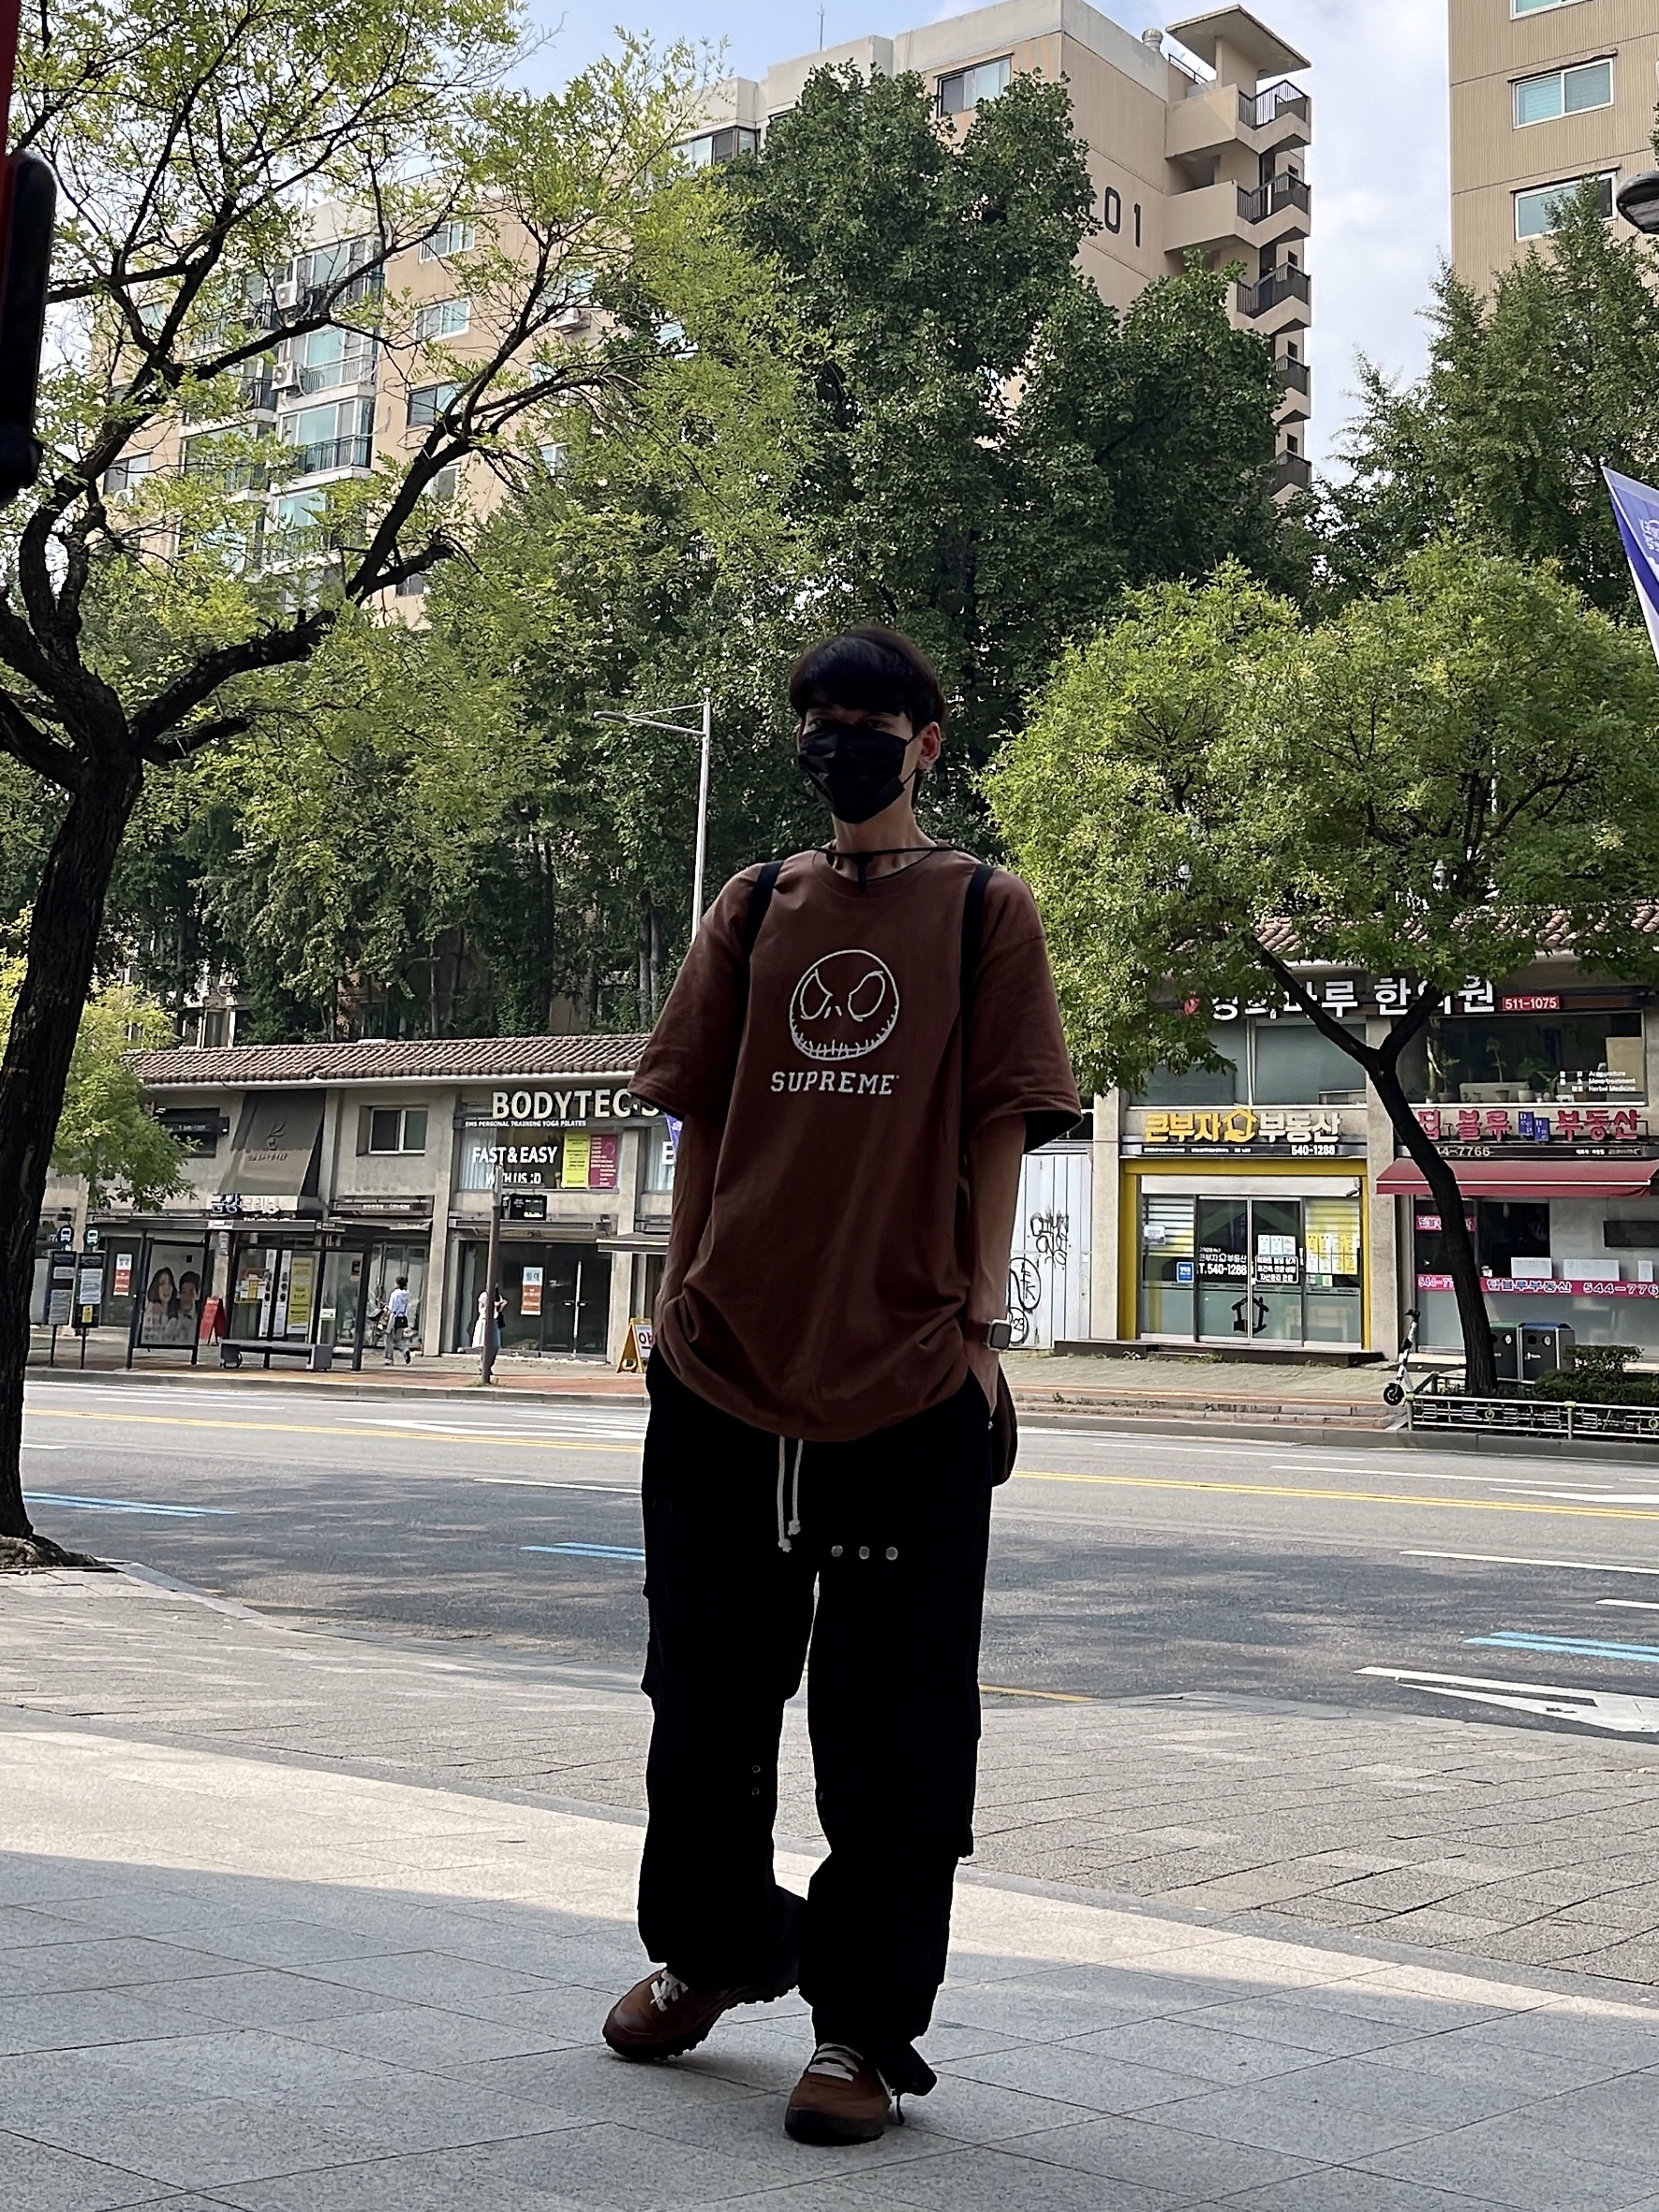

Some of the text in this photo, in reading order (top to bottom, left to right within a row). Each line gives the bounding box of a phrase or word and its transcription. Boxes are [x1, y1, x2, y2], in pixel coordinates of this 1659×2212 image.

[1505, 996, 1557, 1009] 511-1075
[770, 1071, 896, 1095] SUPREME
[1145, 1111, 1341, 1143] 큰부자 부동산
[1556, 1109, 1640, 1141] 부동산
[472, 1146, 558, 1164] FAST & EASY
[1291, 1144, 1336, 1155] 540-1288
[485, 1172, 512, 1185] WH
[1199, 1262, 1248, 1276] T.540-1288
